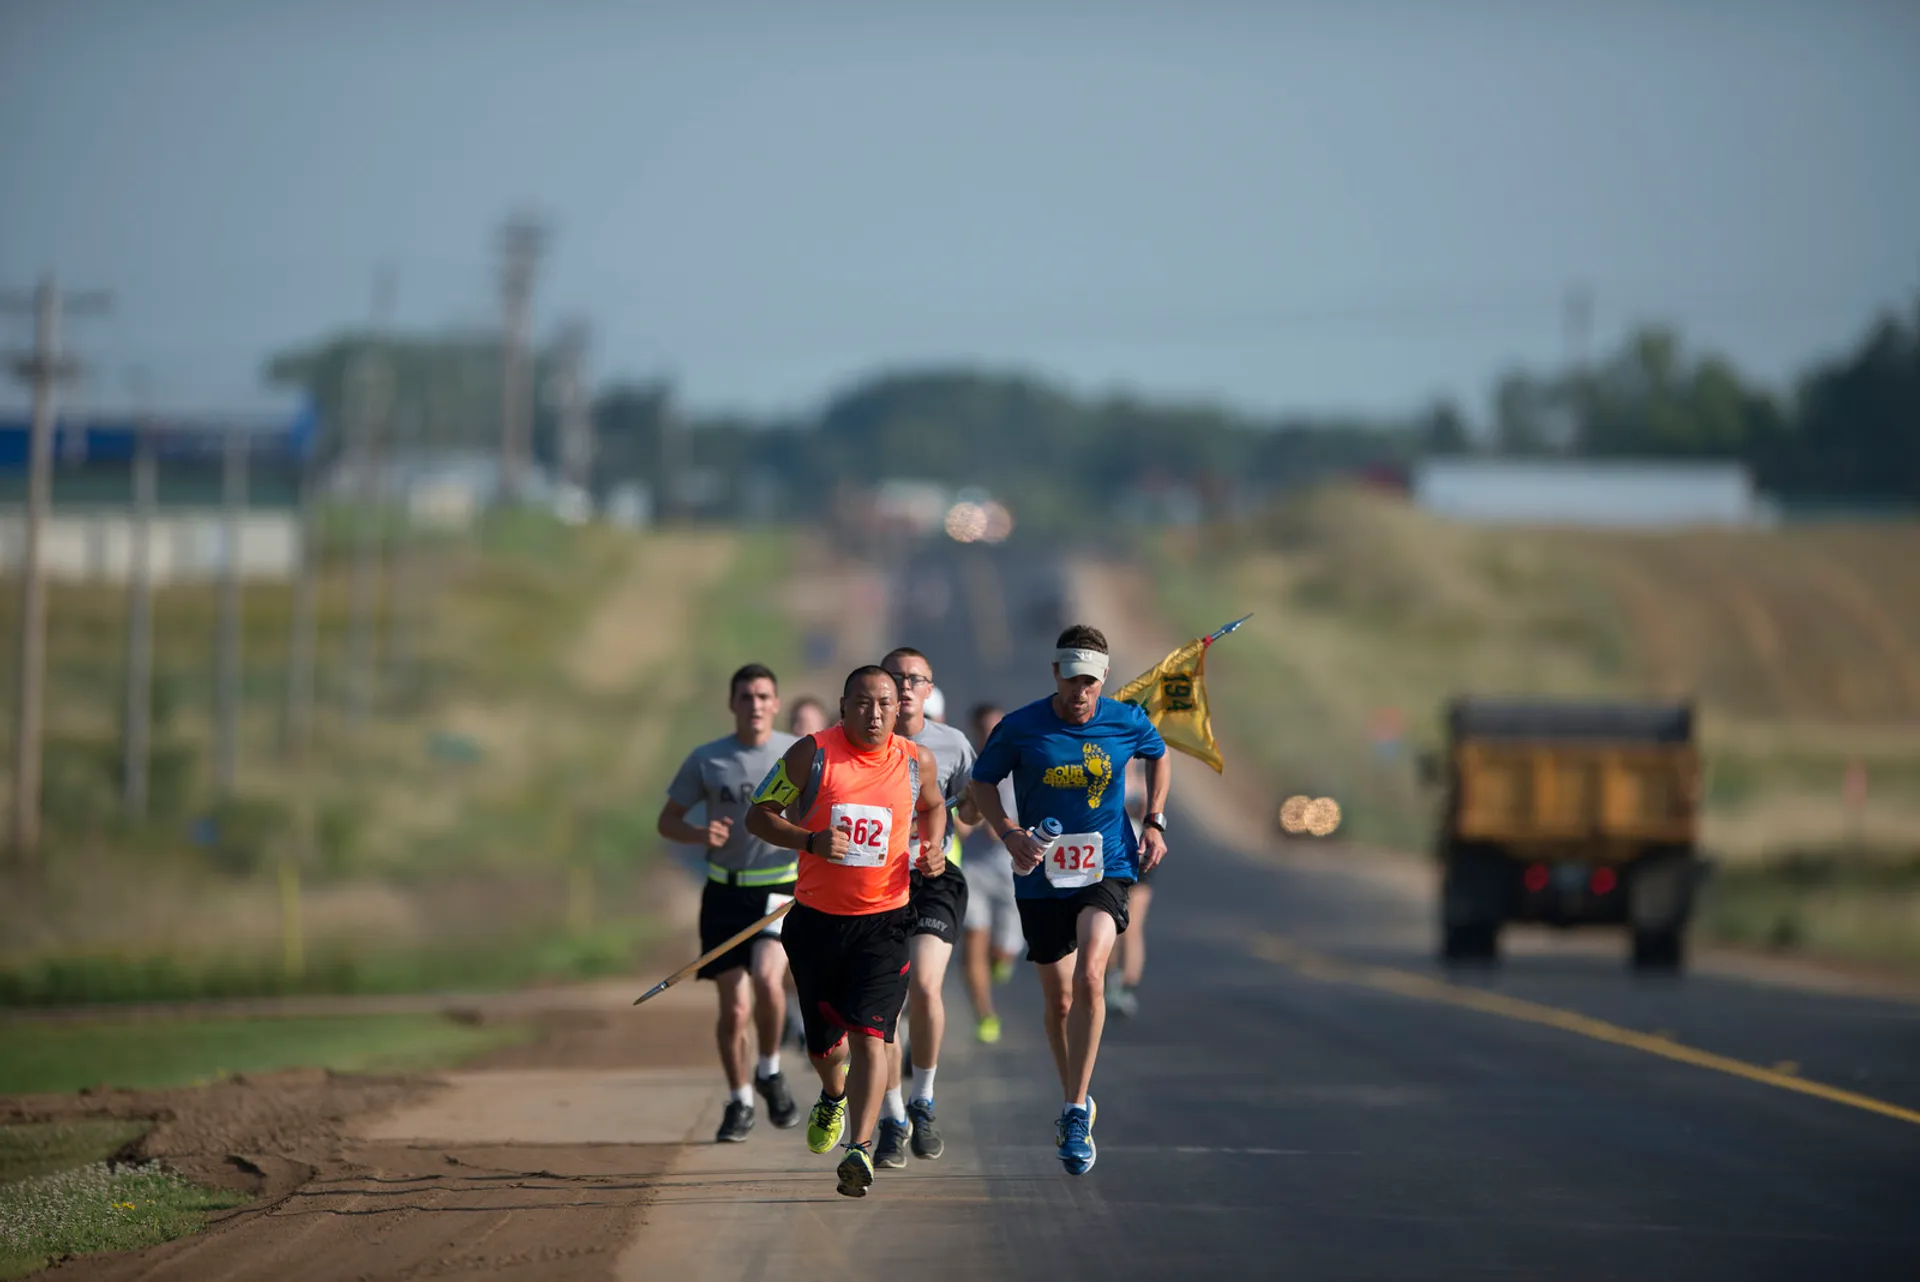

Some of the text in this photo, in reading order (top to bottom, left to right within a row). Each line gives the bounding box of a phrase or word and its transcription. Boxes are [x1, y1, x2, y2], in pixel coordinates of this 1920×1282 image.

[1162, 673, 1193, 712] 194
[719, 782, 753, 805] AR
[1053, 844, 1096, 870] 432
[917, 916, 948, 932] ARMY
